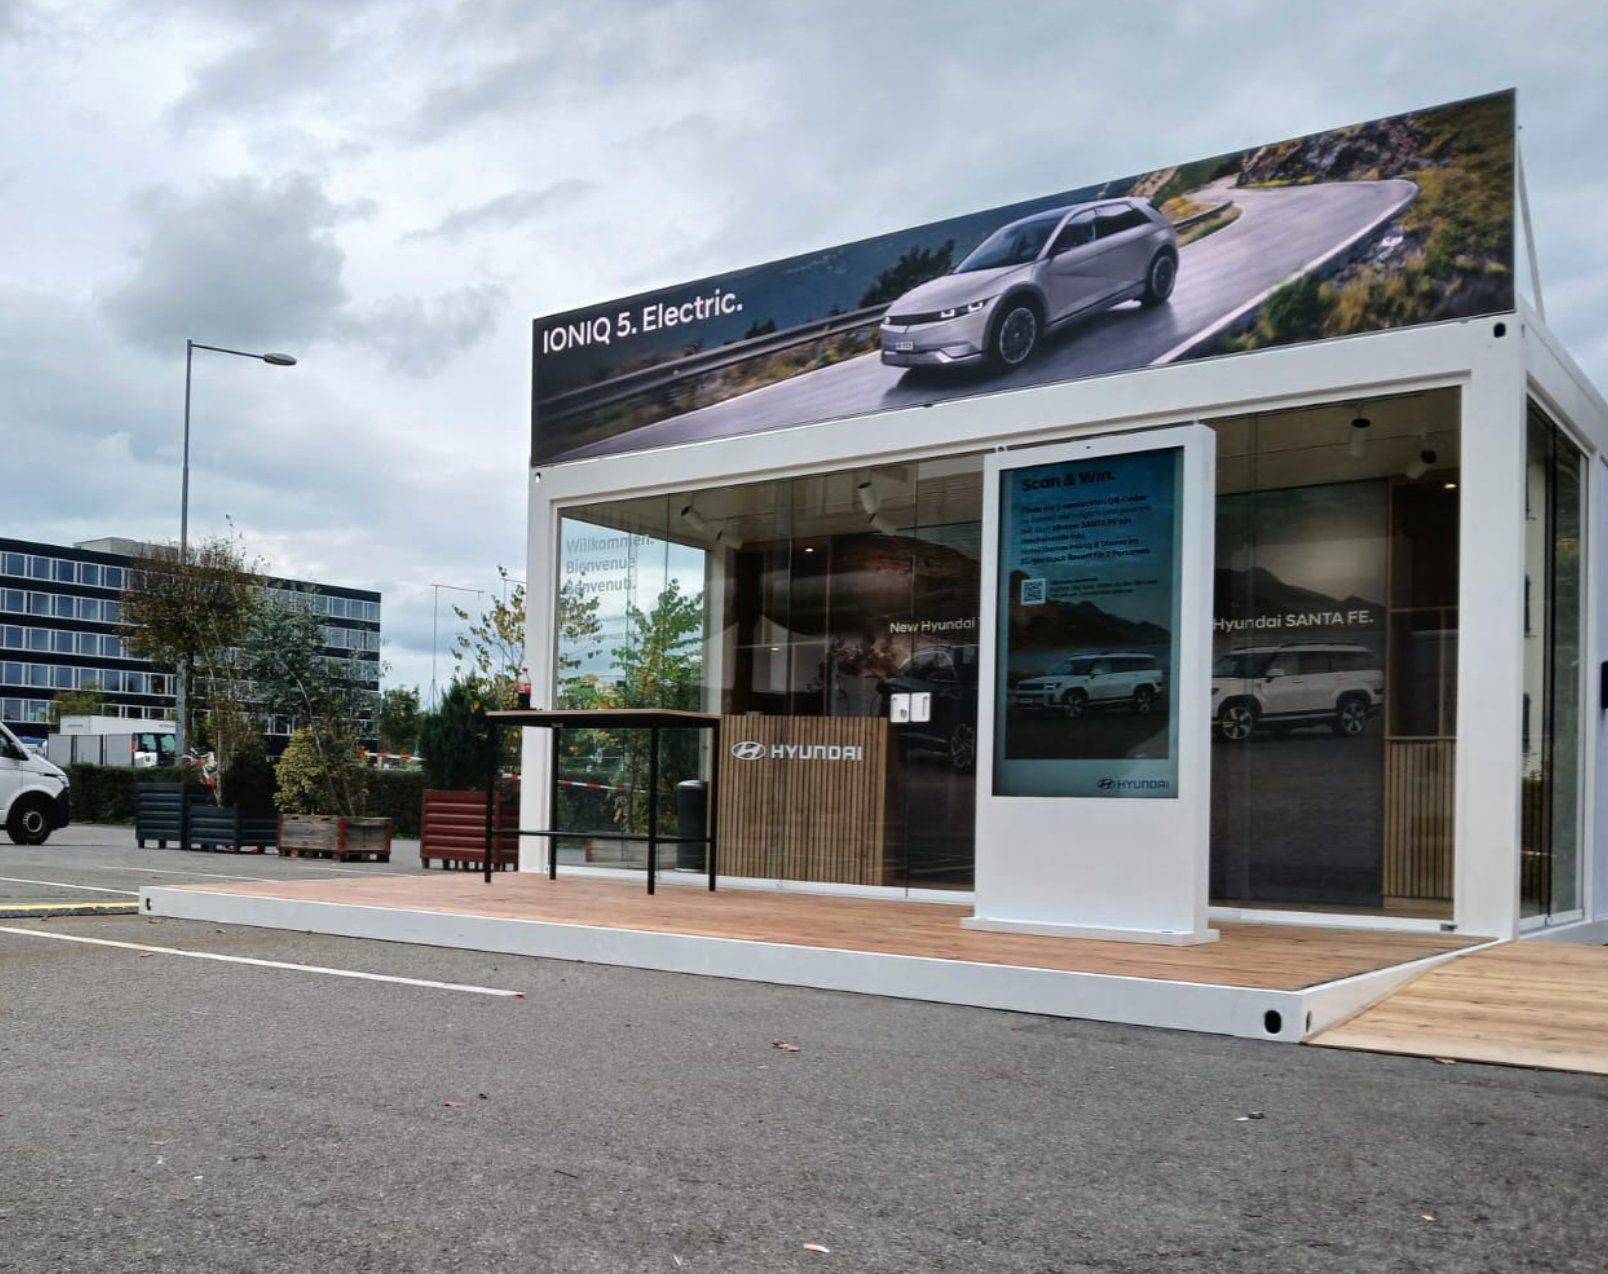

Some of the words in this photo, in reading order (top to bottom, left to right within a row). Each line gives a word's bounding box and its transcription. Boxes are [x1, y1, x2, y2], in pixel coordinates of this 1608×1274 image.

[543, 316, 611, 354] IONIQ
[617, 311, 638, 338] 5.
[643, 288, 743, 332] Electric.
[1021, 477, 1061, 492] Scan
[1063, 472, 1075, 487] &
[1079, 469, 1117, 484] Win.
[566, 533, 655, 553] Willkommen.
[890, 621, 919, 634] New
[920, 616, 976, 634] Hyundai
[1213, 613, 1282, 633] Hyundai
[1285, 611, 1344, 628] SANTA
[1347, 610, 1375, 624] FE.
[771, 743, 862, 761] HYUNDAI
[1116, 779, 1170, 790] HYUNDAI
